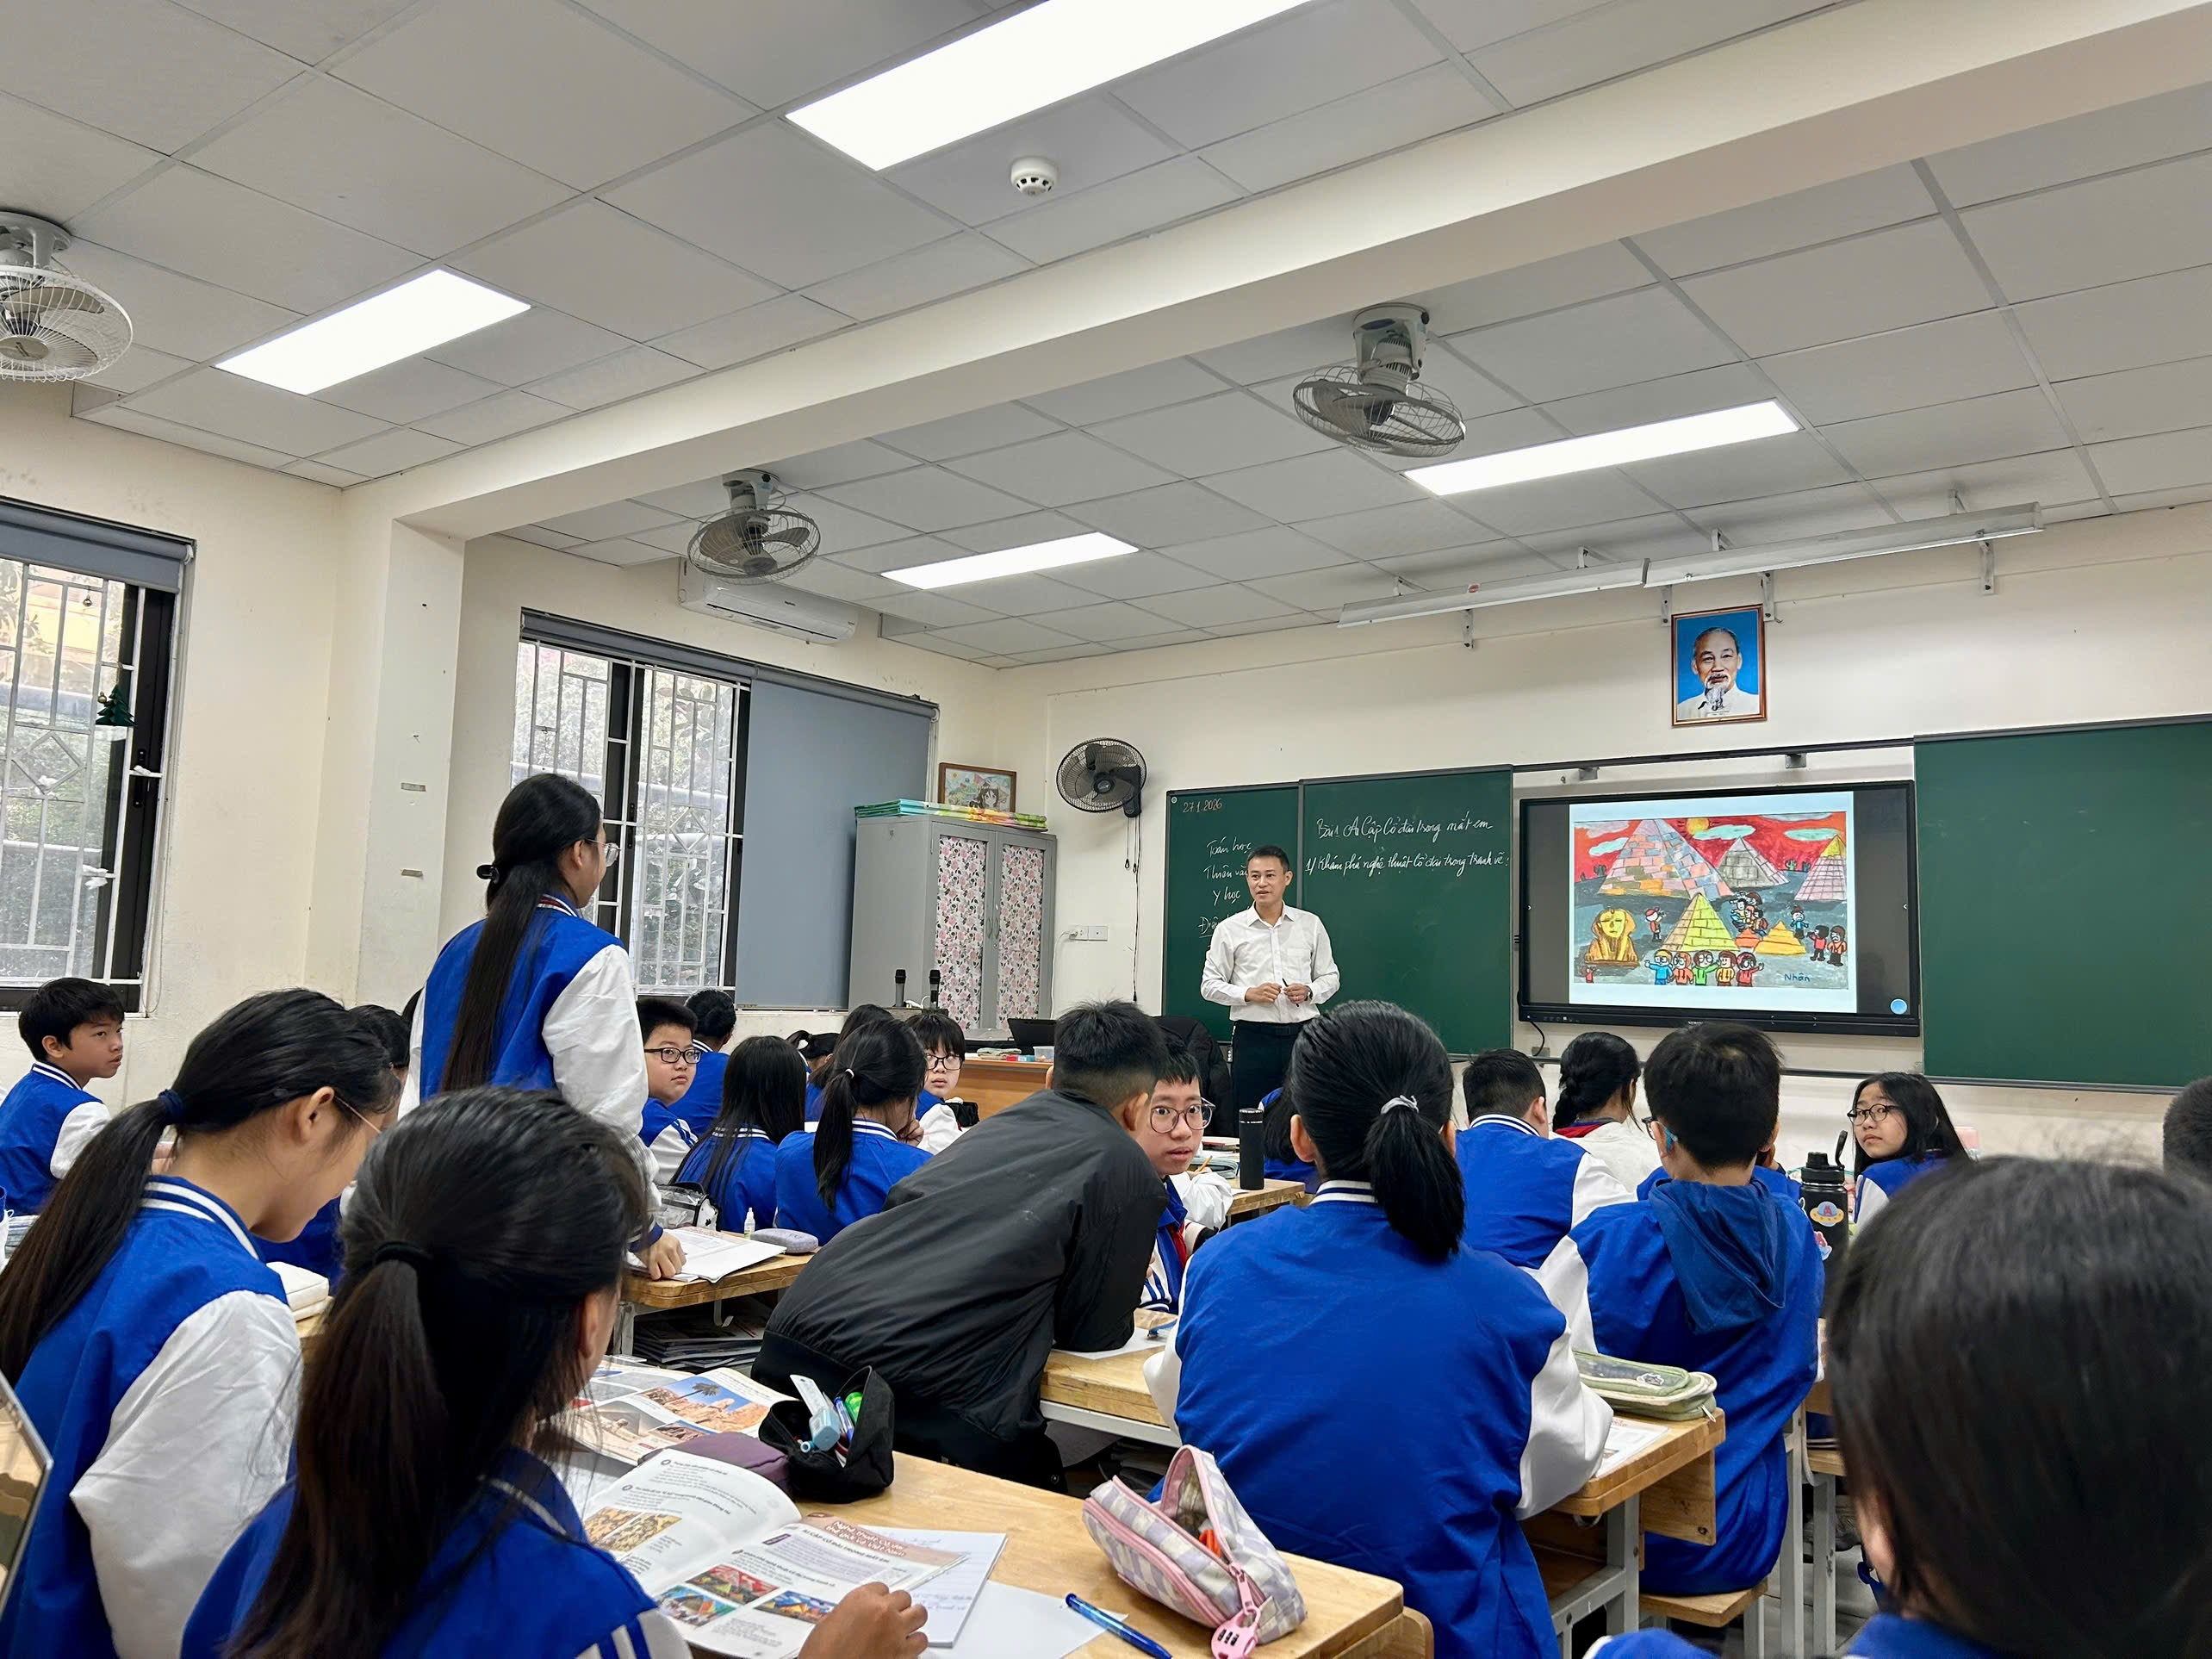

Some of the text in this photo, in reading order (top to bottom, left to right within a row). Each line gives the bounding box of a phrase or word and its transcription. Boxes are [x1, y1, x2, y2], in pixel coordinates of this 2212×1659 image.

[1232, 836, 1252, 854] học
[1223, 885, 1241, 904] học
[1784, 972, 1811, 982] Nhân
